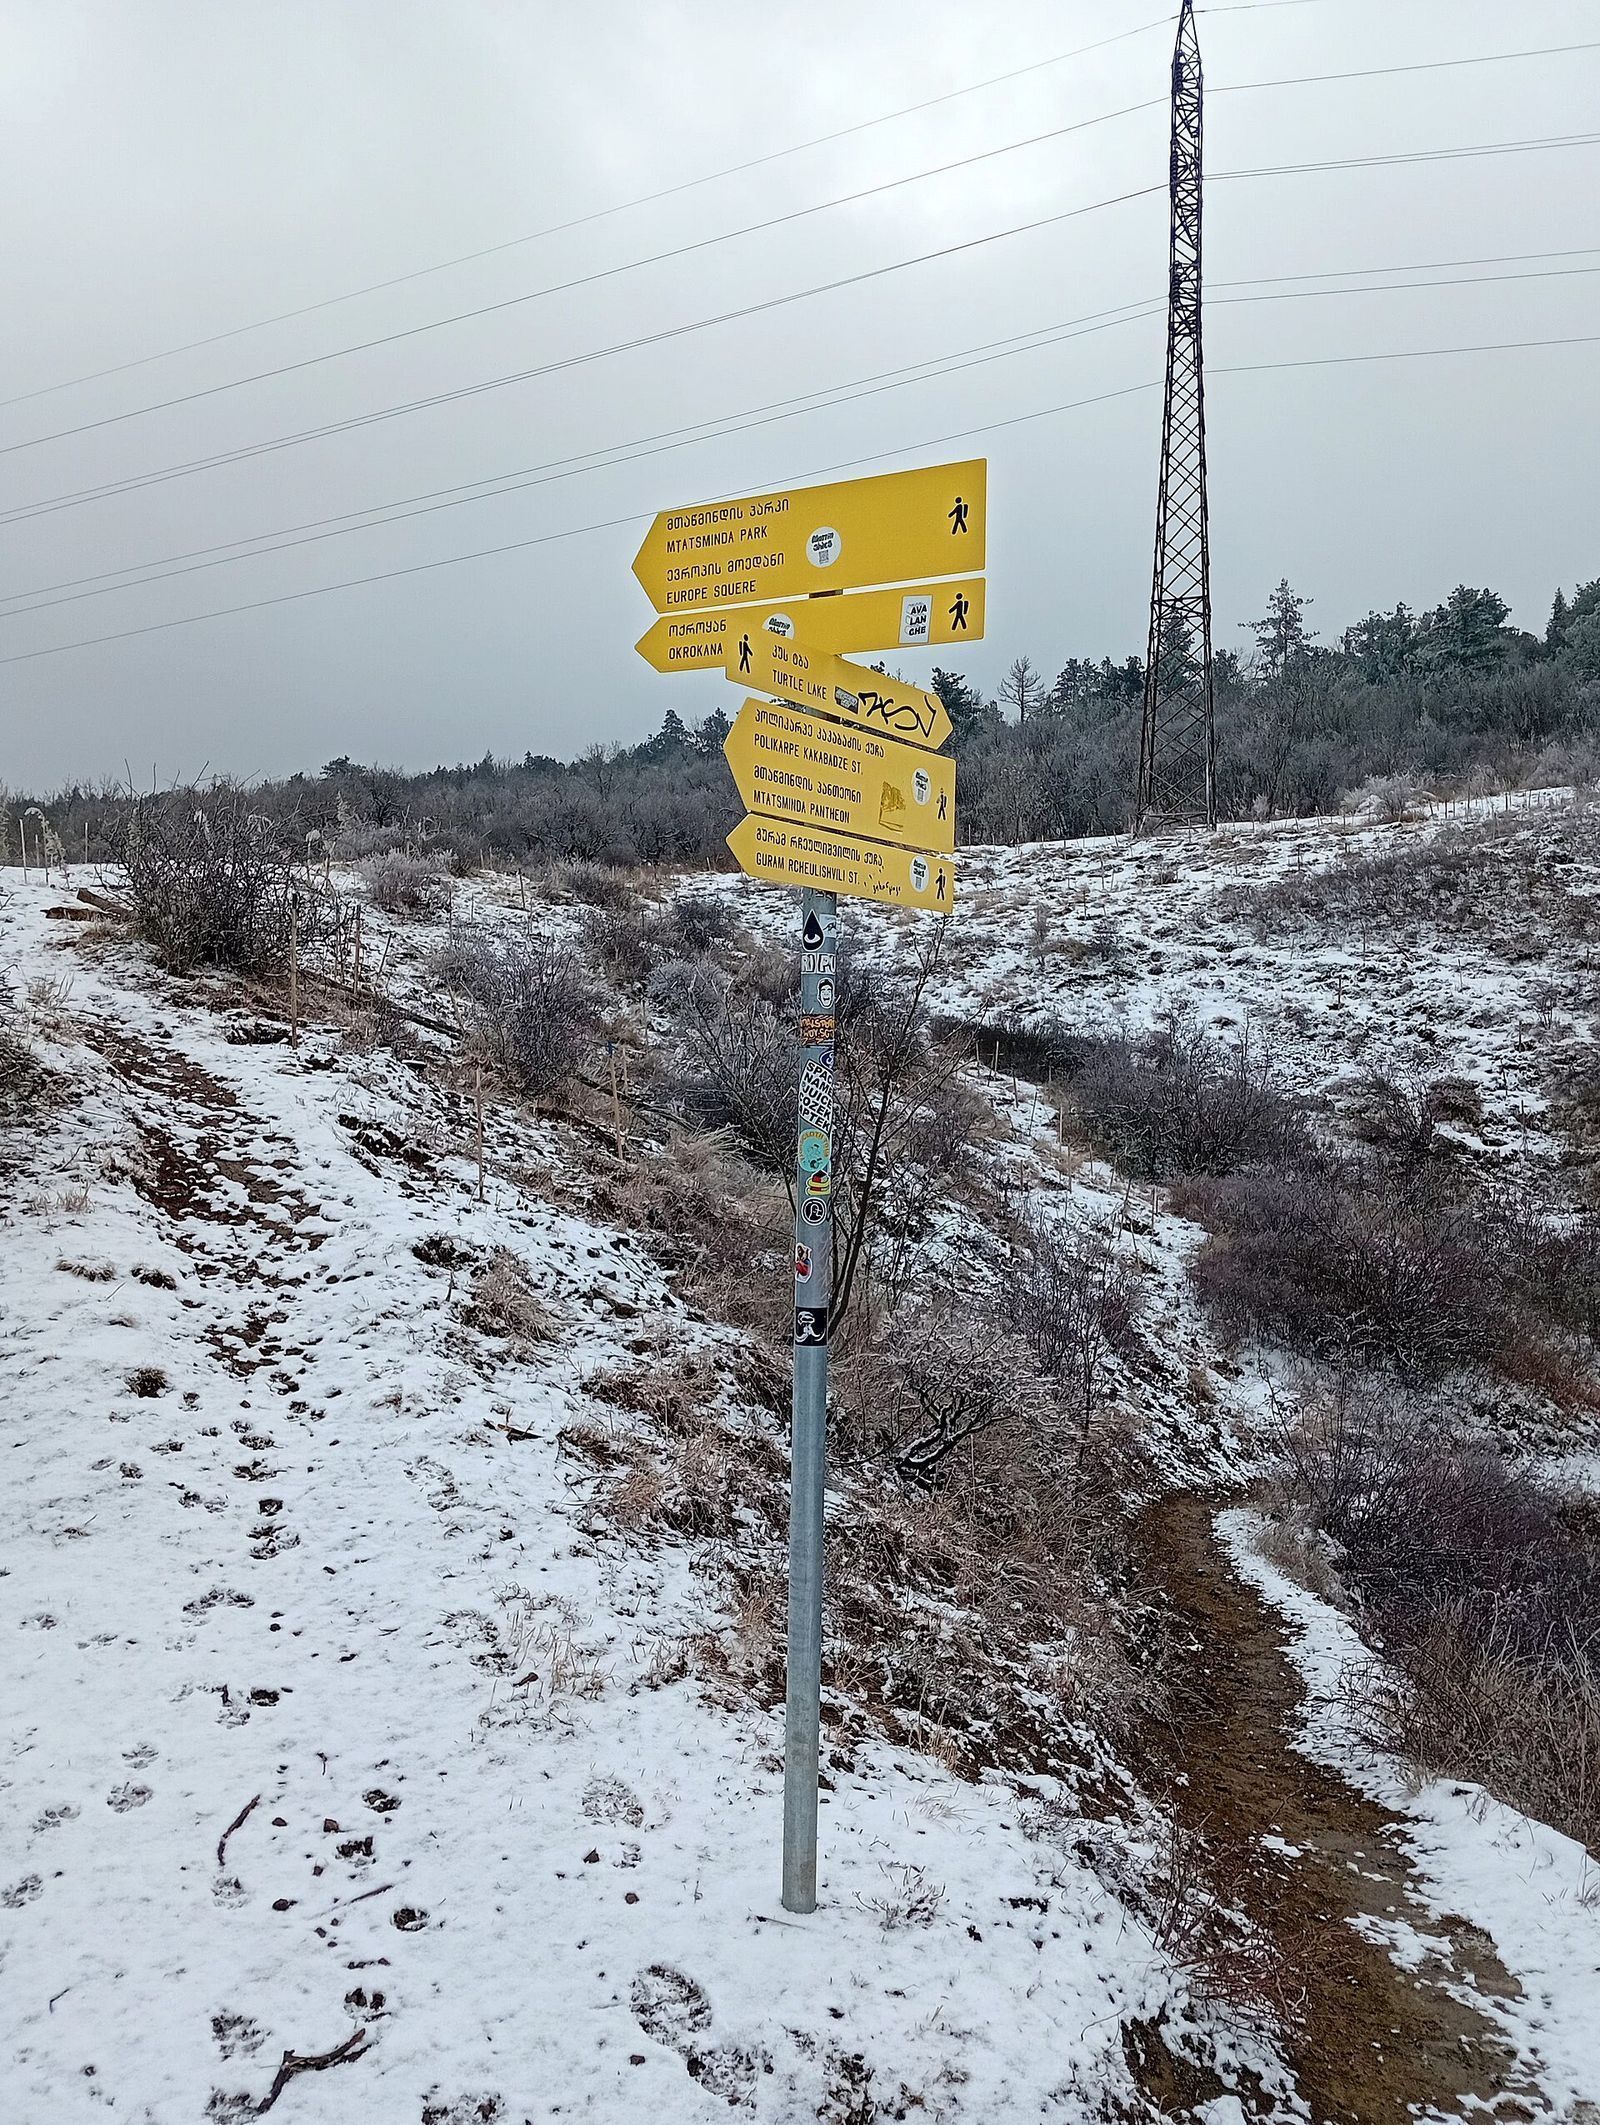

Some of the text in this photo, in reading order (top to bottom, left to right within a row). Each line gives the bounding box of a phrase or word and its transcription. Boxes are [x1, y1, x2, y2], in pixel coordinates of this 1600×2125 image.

[667, 499, 789, 530] მთაწმინდის პარკი
[667, 526, 767, 553] MTATSMINDA PARK
[667, 553, 784, 581] ევროპის მოედანი
[667, 580, 756, 604] EUROPE SQUERE
[910, 615, 926, 625] LAN
[911, 605, 927, 614] AVA
[669, 619, 726, 637] ოქროყან
[669, 643, 723, 659] OKROKANA
[773, 645, 809, 669] კუს ტბა
[773, 669, 803, 692] TURTLE
[807, 683, 827, 700] LAKE
[754, 733, 863, 775] POLIKARPE KAKABADZE ST.
[754, 765, 861, 803] მთაწმინდის პანთეონი
[754, 790, 850, 823] MTATSMINDA PANTHEON
[756, 827, 786, 845] გურამ
[756, 852, 860, 885] GURAM RCHEULISHVILI ST.
[807, 1062, 832, 1084] SPAC
